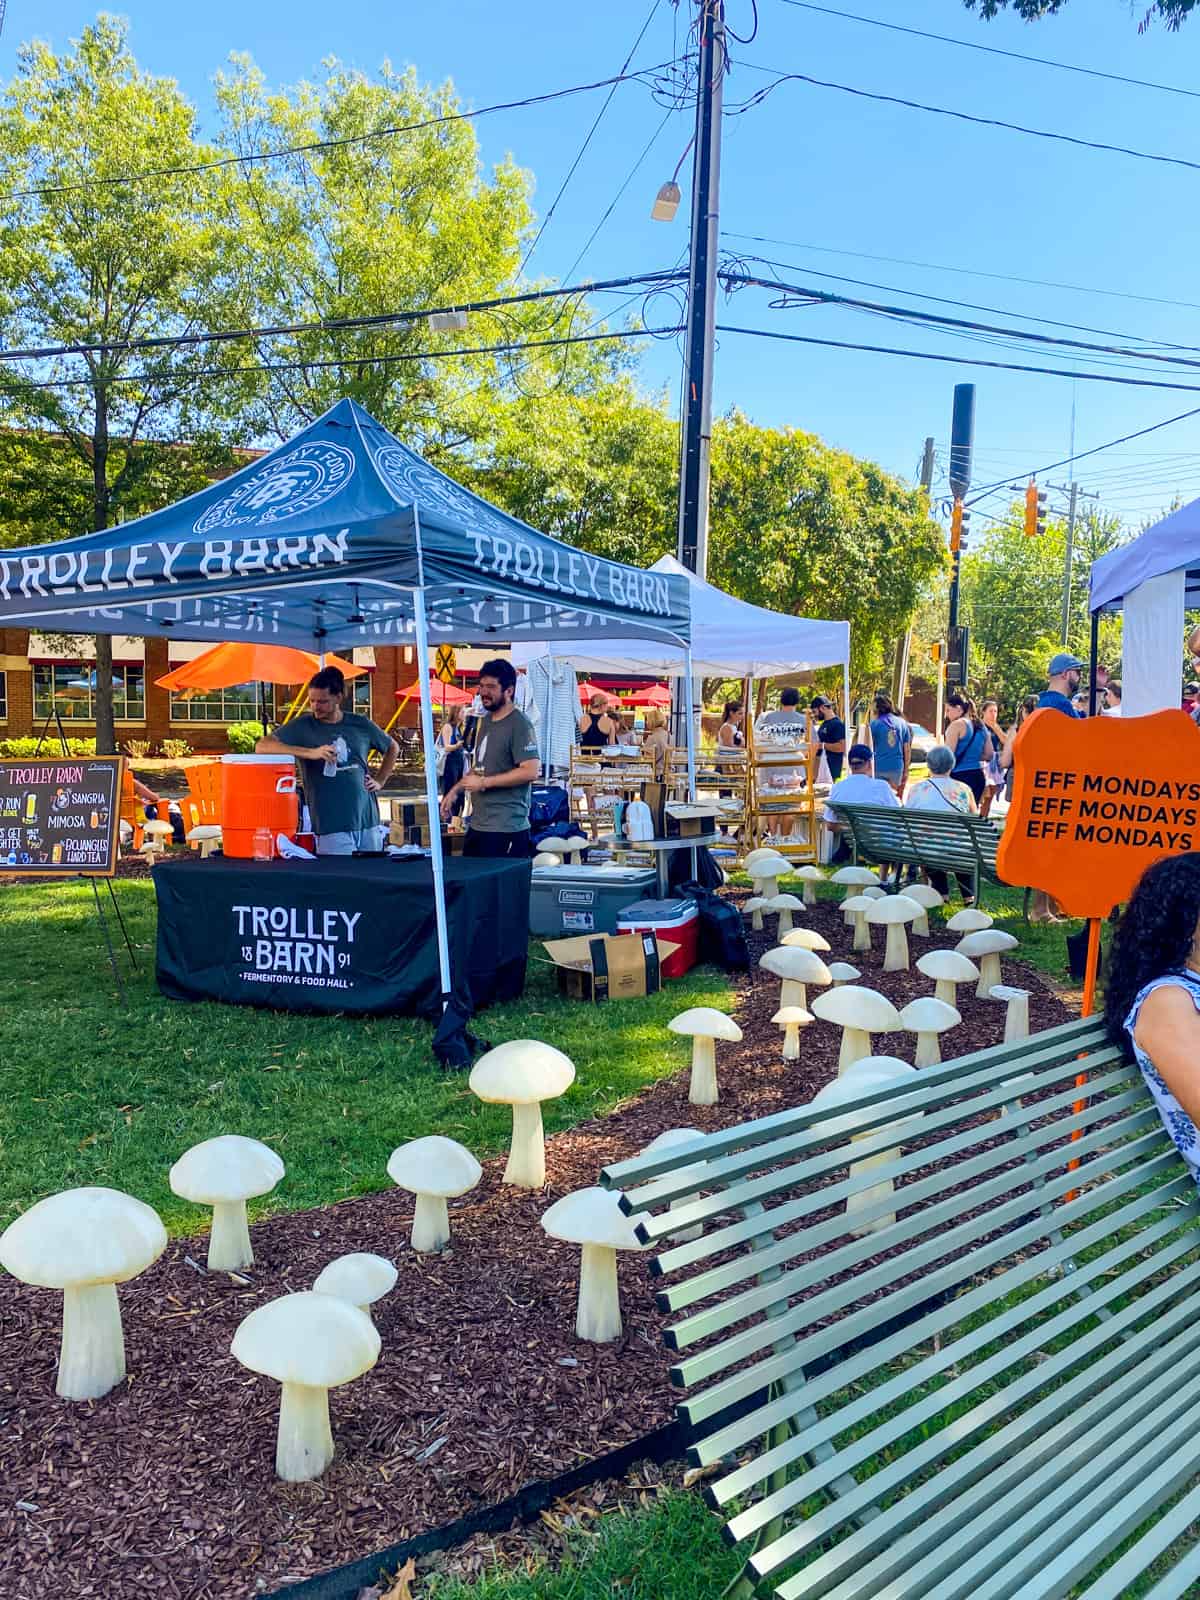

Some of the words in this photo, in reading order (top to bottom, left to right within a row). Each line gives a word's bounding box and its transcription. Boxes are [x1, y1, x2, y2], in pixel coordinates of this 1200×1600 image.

[0, 542, 187, 600] TROLLEY
[200, 528, 350, 580] BARN
[465, 529, 602, 600] TROLLEY
[608, 567, 674, 617] BARN
[7, 767, 54, 785] TROLLEY
[56, 766, 84, 783] BARN
[1034, 771, 1077, 790] EFF
[1082, 774, 1200, 801] MONDAYS
[71, 792, 105, 805] SANGRIA
[1030, 796, 1073, 816] EFF
[1079, 800, 1197, 826] MONDAYS
[47, 815, 86, 829] MIMOSA
[1026, 820, 1069, 839] EFF
[1074, 823, 1193, 850] MONDAYS
[231, 905, 362, 943] TROLLEY
[255, 939, 335, 975] BARN
[338, 953, 350, 968] 91
[243, 972, 294, 984] FERMENTORY
[295, 976, 301, 985] &
[302, 977, 326, 987] FOOD
[327, 978, 349, 989] HALL
